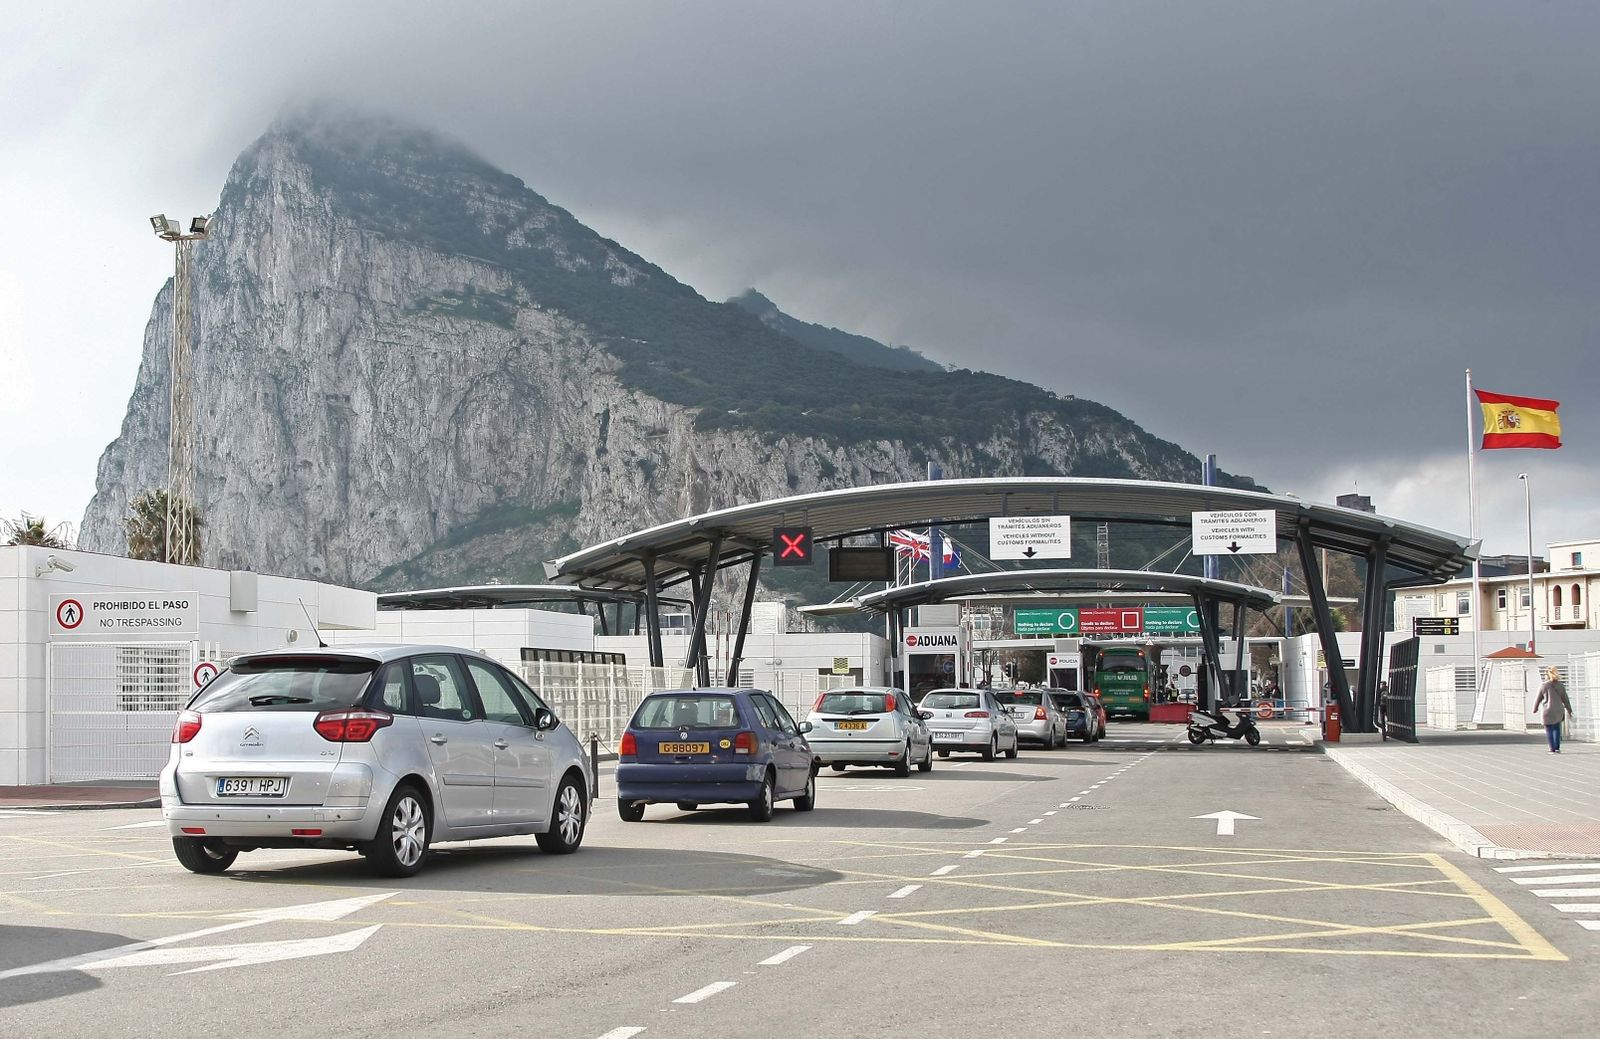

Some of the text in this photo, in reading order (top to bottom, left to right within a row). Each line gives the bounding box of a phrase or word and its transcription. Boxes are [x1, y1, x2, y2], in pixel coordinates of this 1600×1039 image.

[93, 600, 189, 610] PROHIBIDO EL PASO
[99, 617, 182, 627] NO TRESPASSING
[917, 635, 957, 646] ADUANA
[225, 780, 281, 792] 6391 HPJ
